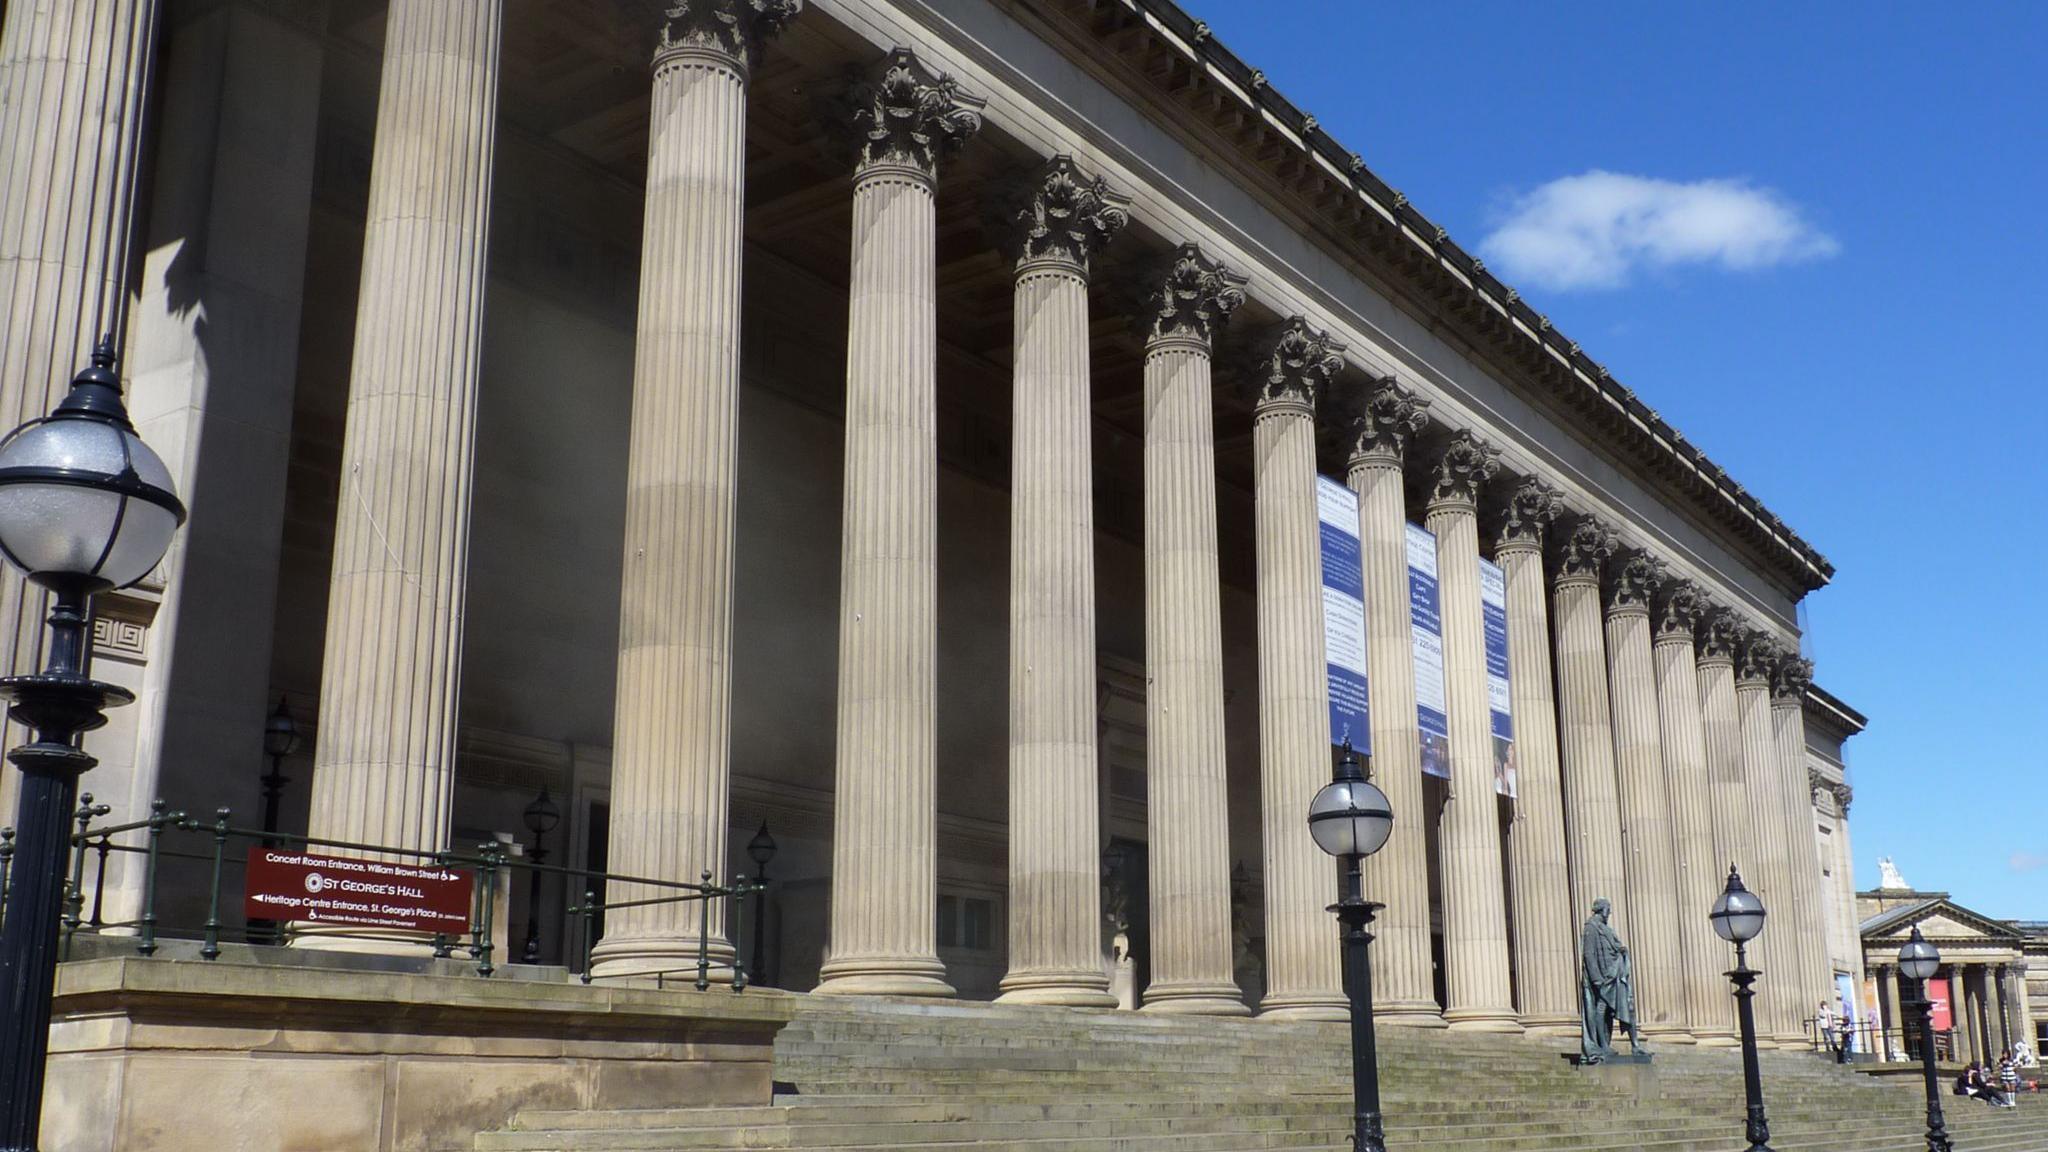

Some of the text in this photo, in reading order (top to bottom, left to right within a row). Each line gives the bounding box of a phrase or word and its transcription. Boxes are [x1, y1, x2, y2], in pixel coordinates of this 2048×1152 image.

[266, 853, 301, 864] Concert
[302, 857, 327, 867] Room
[367, 864, 394, 875] William
[395, 867, 418, 877] Brown
[418, 869, 439, 880] Street
[340, 880, 395, 895] GEORGE'S
[397, 885, 424, 898] HALL
[264, 894, 301, 907] Heritage
[302, 898, 331, 908] Centre
[371, 904, 381, 913] St.
[382, 905, 415, 917] George's
[416, 908, 438, 918] Place
